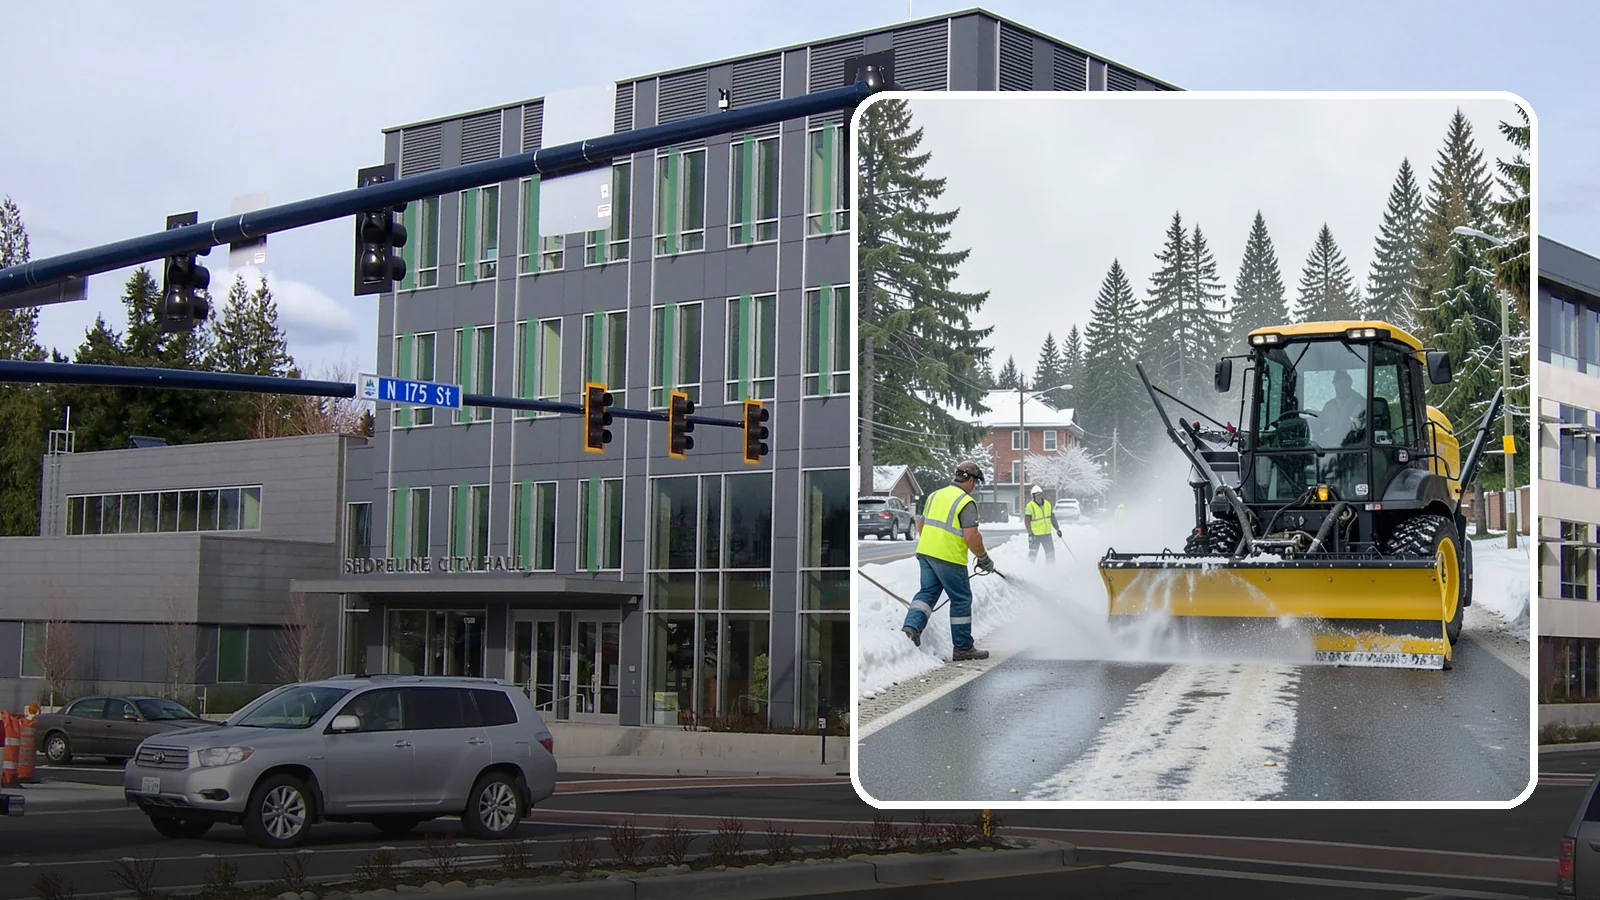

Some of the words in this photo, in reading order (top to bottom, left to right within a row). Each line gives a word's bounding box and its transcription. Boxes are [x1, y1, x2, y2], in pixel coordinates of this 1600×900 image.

[387, 380, 396, 400] N
[405, 382, 427, 403] 175
[436, 386, 452, 406] St
[344, 556, 432, 574] SHORELINE
[438, 555, 476, 573] CITY
[483, 555, 526, 573] HALL
